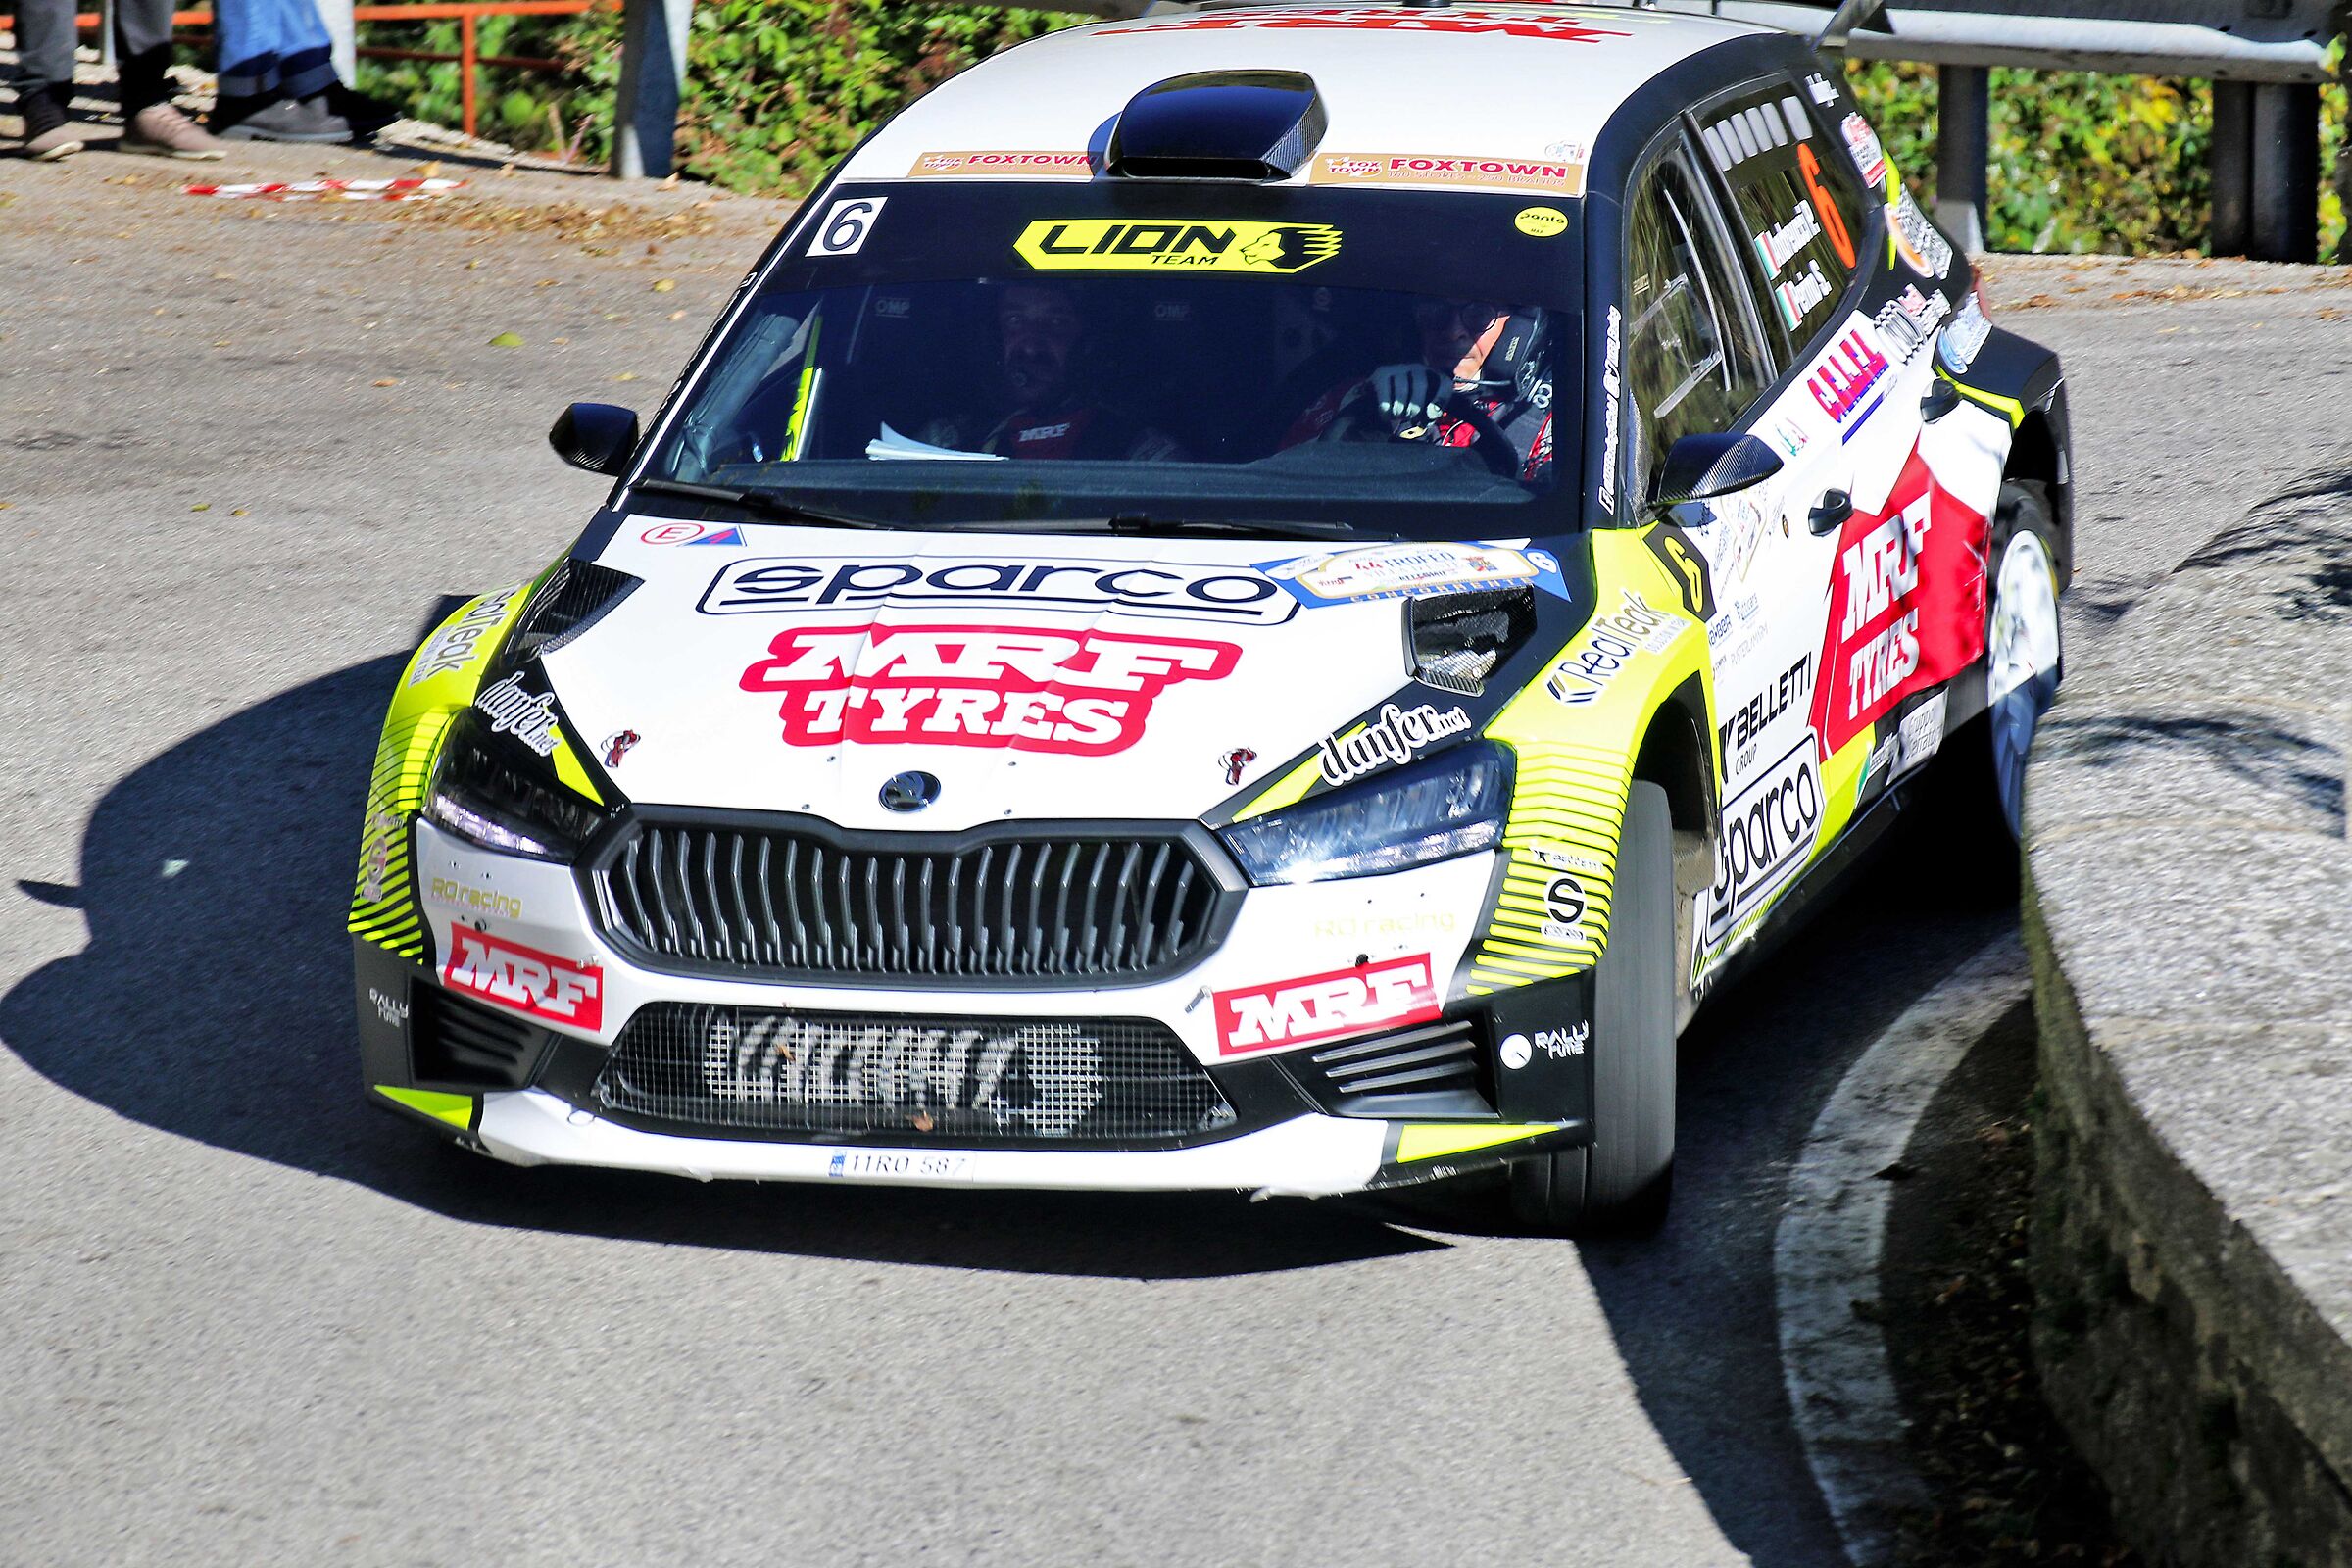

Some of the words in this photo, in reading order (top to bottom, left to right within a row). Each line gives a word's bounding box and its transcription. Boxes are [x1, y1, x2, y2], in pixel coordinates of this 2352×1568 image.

[968, 155, 1098, 166] FOXTOWN
[1390, 159, 1568, 178] FOXTOWN
[821, 201, 872, 252] 6
[1797, 143, 1856, 269] 6
[1040, 224, 1237, 255] LION
[1151, 254, 1220, 266] TEAM
[732, 564, 1278, 605] sparco
[1664, 535, 1701, 613] 6
[1842, 490, 1933, 644] MRF
[762, 629, 1218, 692] MRF
[1848, 607, 1920, 721] TYRES
[803, 687, 1130, 744] TYRES
[1737, 651, 1812, 751] BELLETTI
[1735, 743, 1757, 775] GROUP
[451, 936, 598, 1017] MRF
[1228, 962, 1430, 1048] MRF
[920, 1155, 968, 1175] 587
